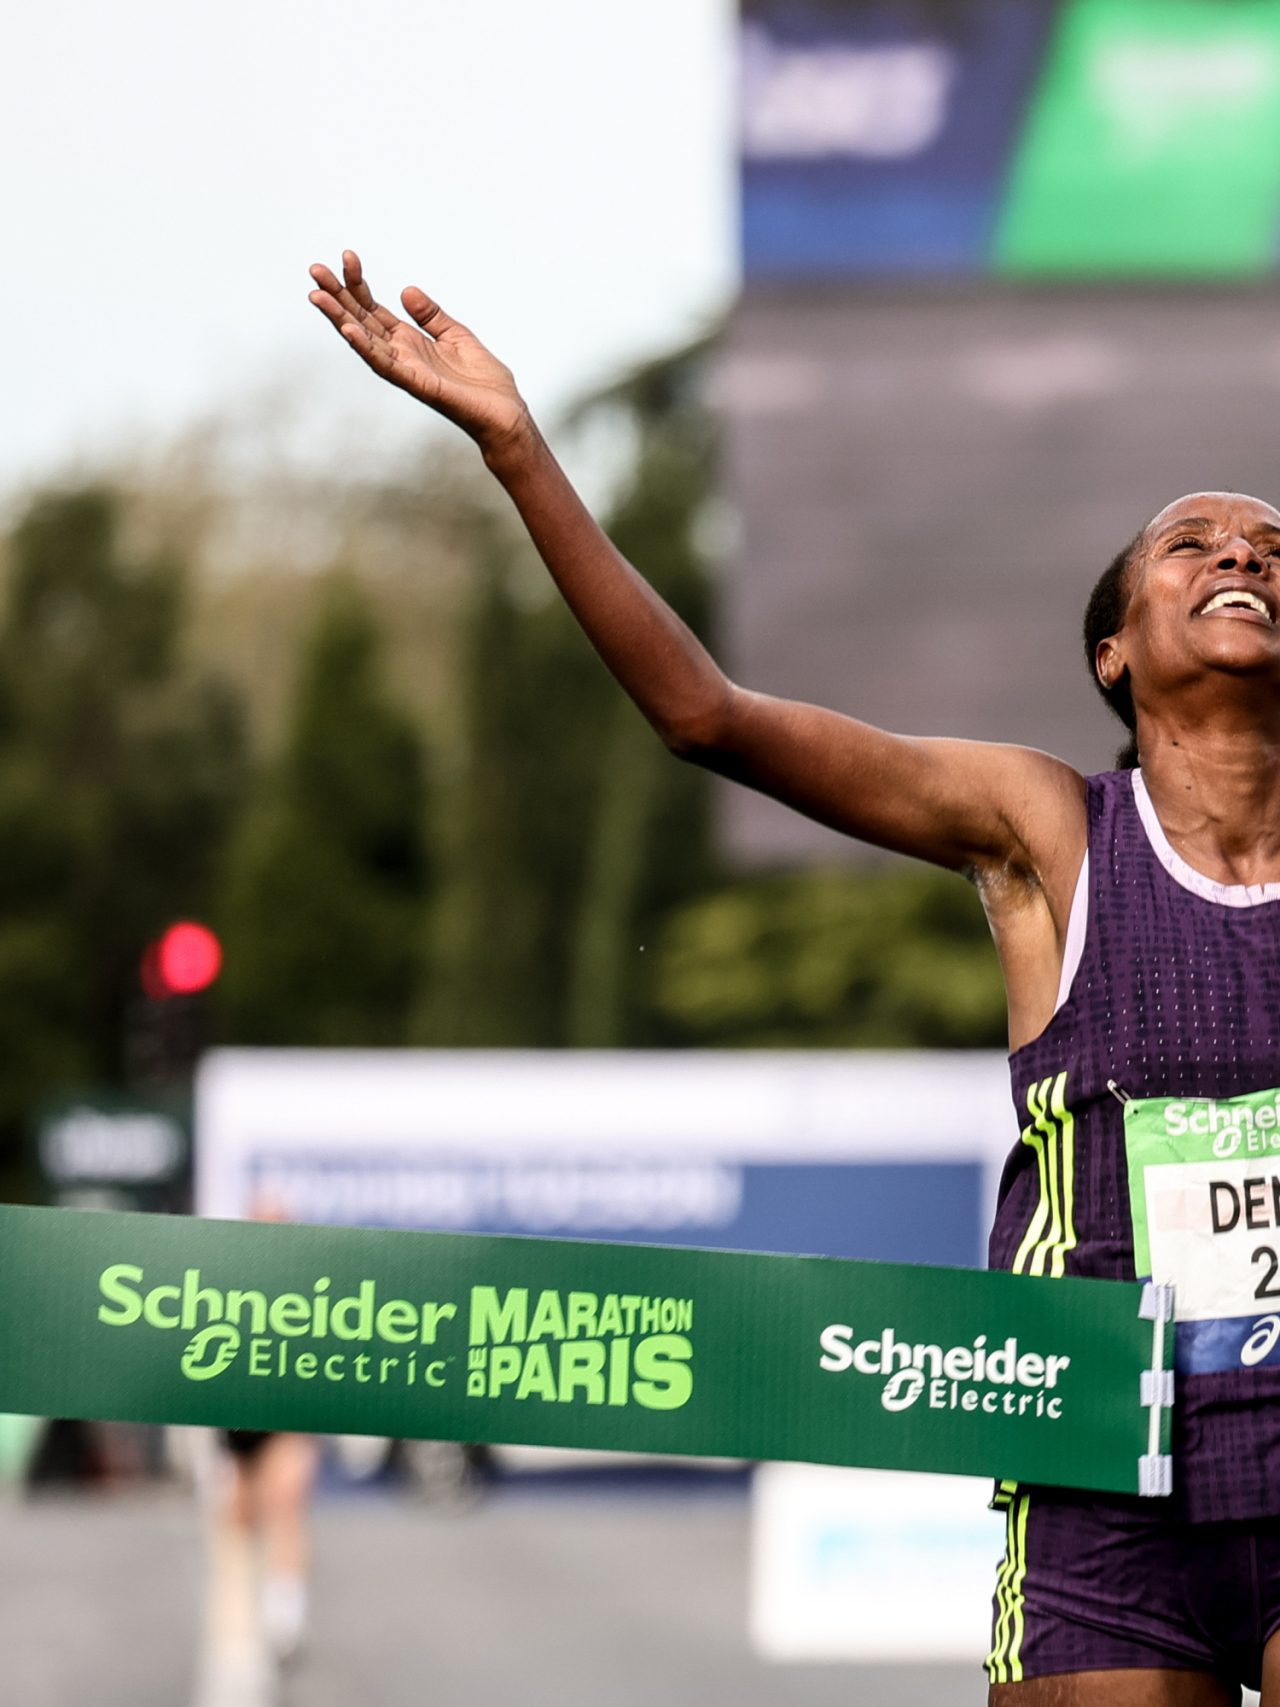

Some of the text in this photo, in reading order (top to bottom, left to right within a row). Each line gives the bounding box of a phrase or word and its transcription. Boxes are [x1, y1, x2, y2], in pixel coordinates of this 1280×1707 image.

[98, 1263, 458, 1345] Schneider
[468, 1285, 693, 1346] MARATHON
[249, 1338, 446, 1388] Electric
[466, 1333, 694, 1411] DE PARIS
[819, 1323, 1071, 1388] Schneider
[929, 1378, 1063, 1420] Electric
